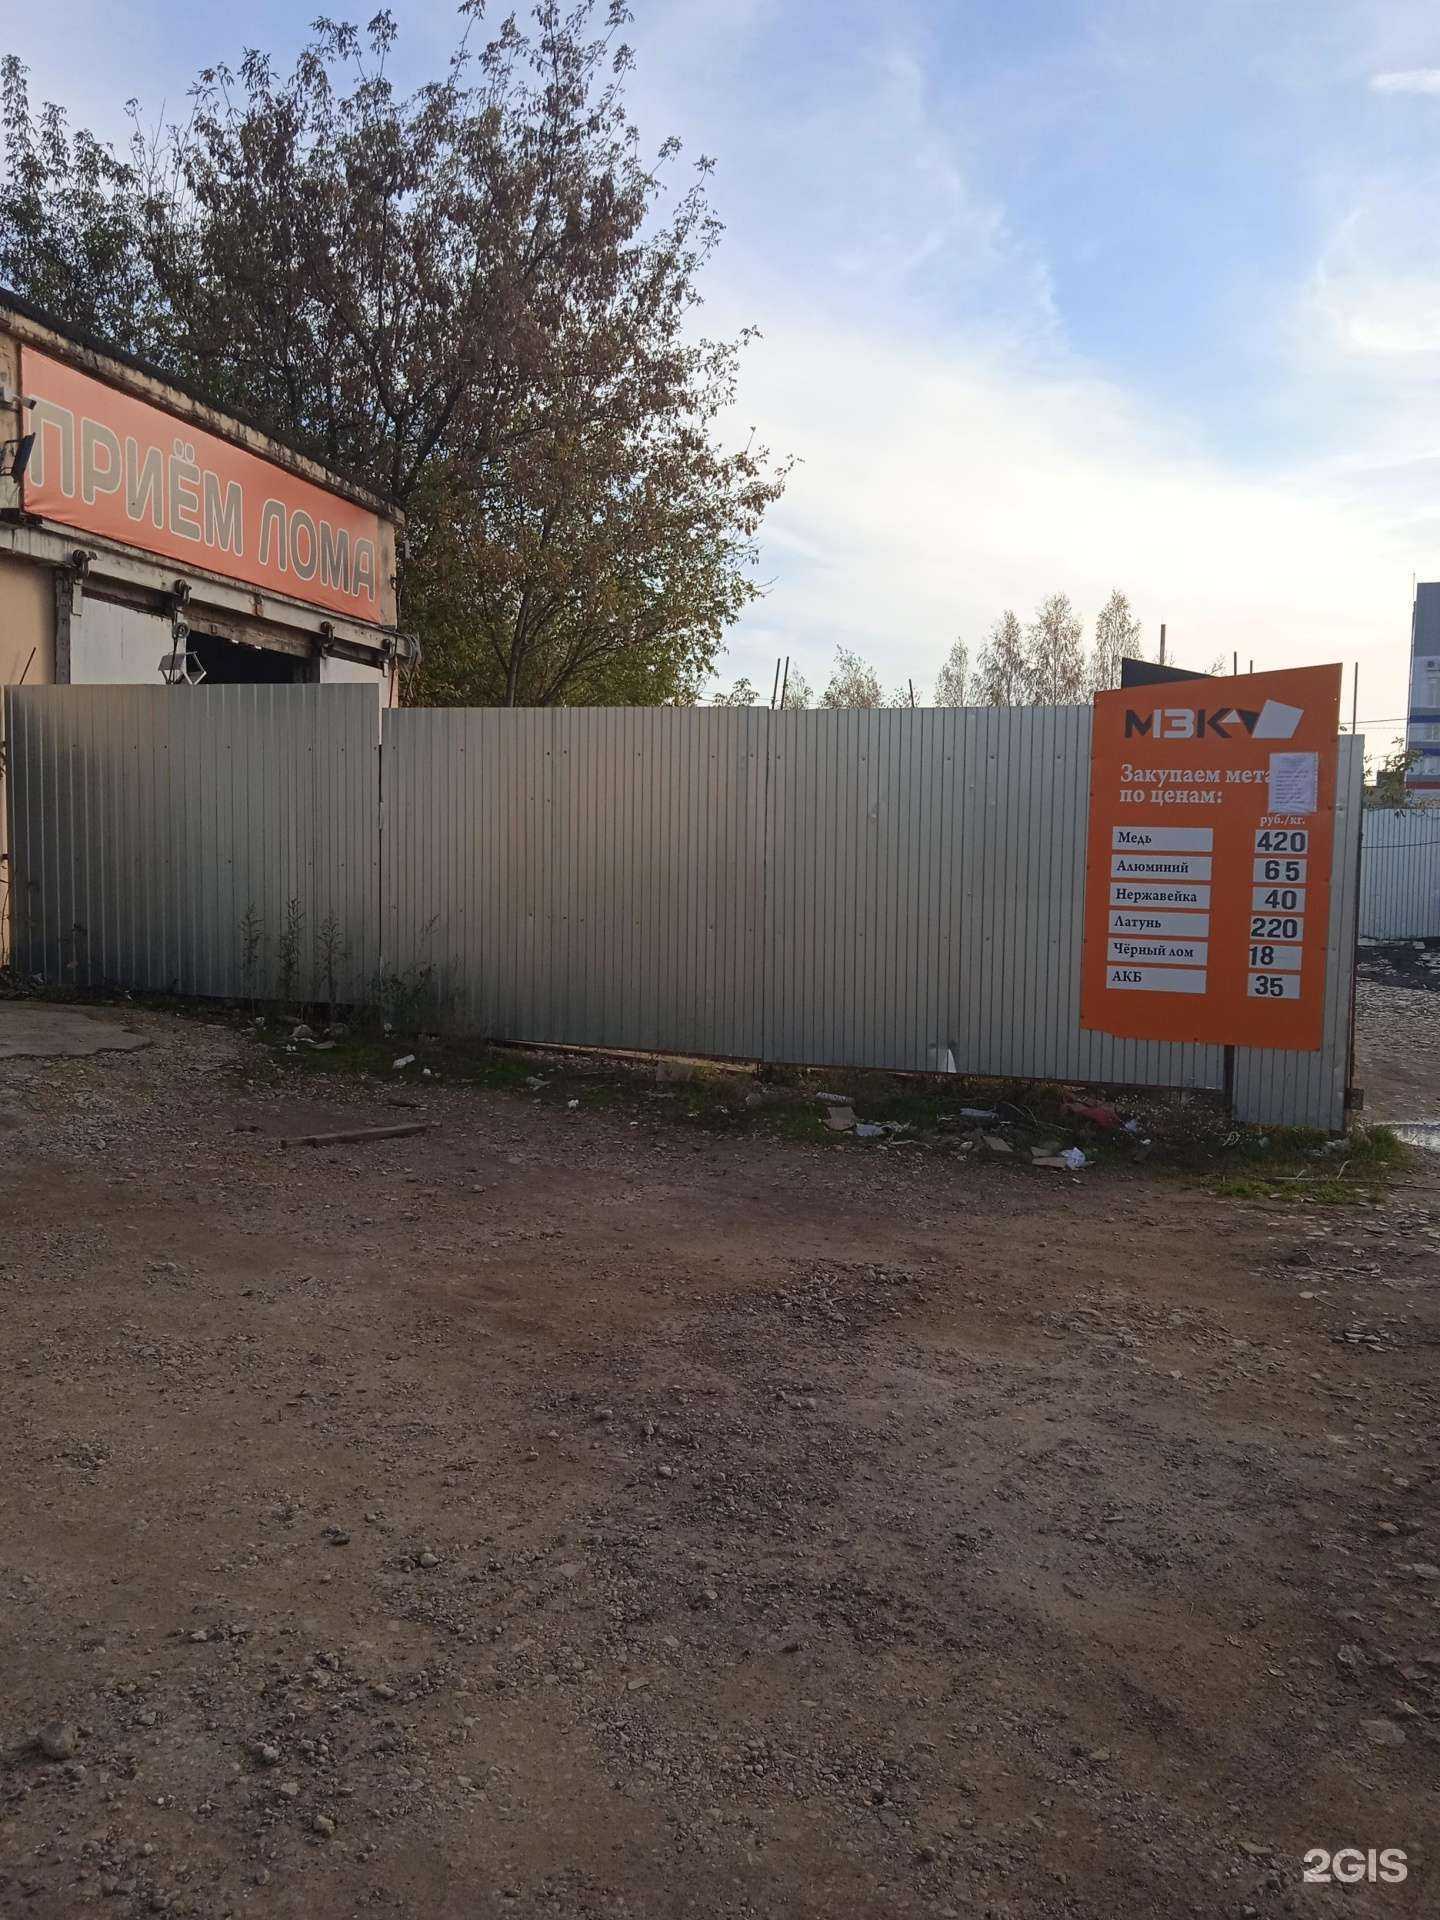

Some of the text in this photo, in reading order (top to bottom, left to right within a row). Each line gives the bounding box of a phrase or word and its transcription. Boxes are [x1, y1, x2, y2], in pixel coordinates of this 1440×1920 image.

[28, 393, 376, 602] ПРИЁМ ЛОМА
[1120, 764, 1220, 787] Закупаем
[1119, 789, 1223, 806] по ценам:
[1259, 814, 1306, 827] руб./кг.
[1117, 831, 1152, 845] Медь
[1257, 831, 1306, 852] 420
[1116, 859, 1189, 874] Алюминий
[1264, 860, 1300, 882] 65
[1115, 887, 1198, 903] Нержавейка
[1264, 889, 1298, 911] 40
[1113, 915, 1162, 930] Латунь
[1250, 917, 1298, 939] 220
[1112, 942, 1194, 958] Чёрный лом
[1248, 945, 1275, 966] 18
[1111, 970, 1143, 983] АКБ
[1254, 975, 1284, 997] 35
